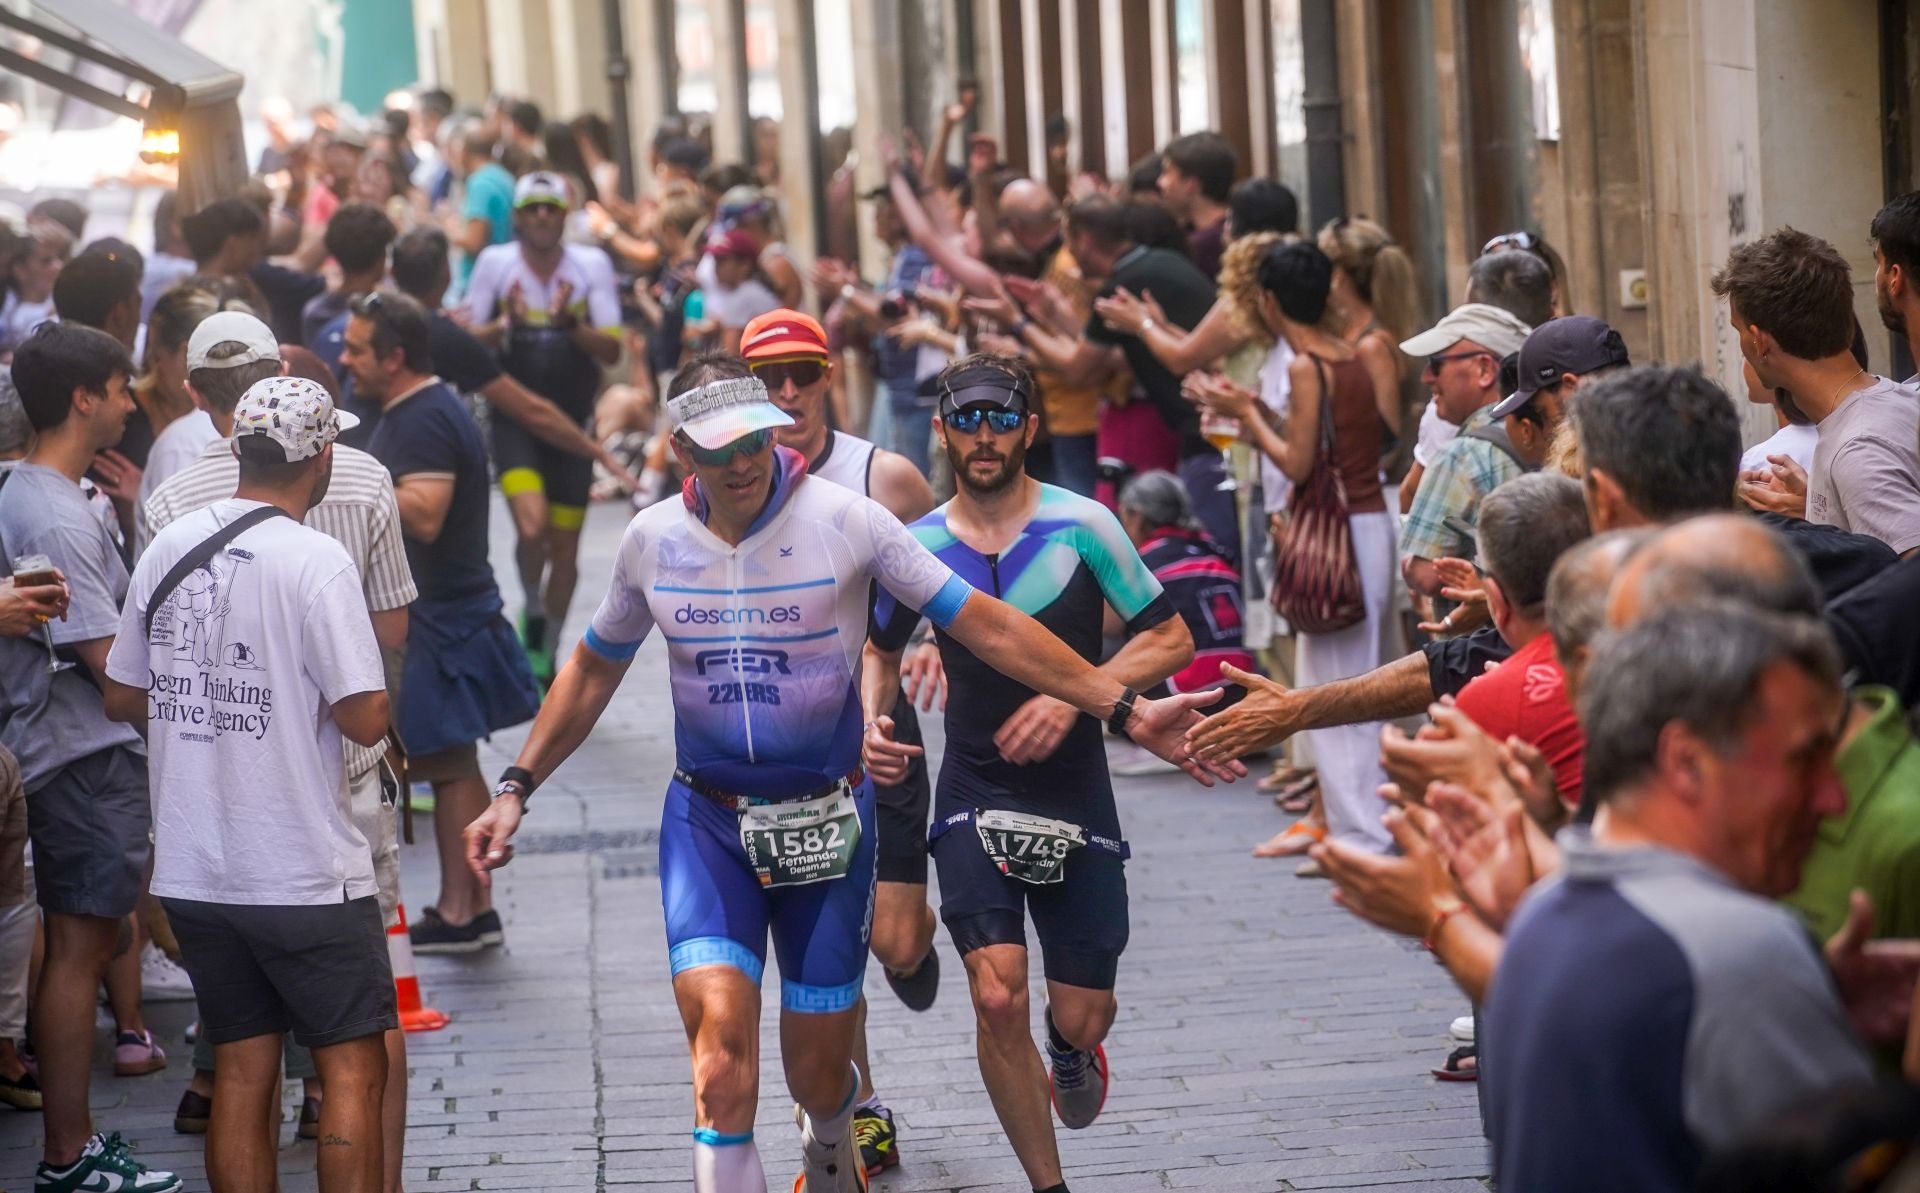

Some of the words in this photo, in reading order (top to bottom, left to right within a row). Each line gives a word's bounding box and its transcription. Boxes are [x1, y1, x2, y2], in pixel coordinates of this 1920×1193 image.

[675, 603, 800, 624] desam.es
[207, 702, 271, 740] Agency
[763, 821, 846, 857] 1582
[996, 832, 1069, 859] 1748
[778, 850, 838, 868] Fernando
[790, 861, 831, 875] Desam.es
